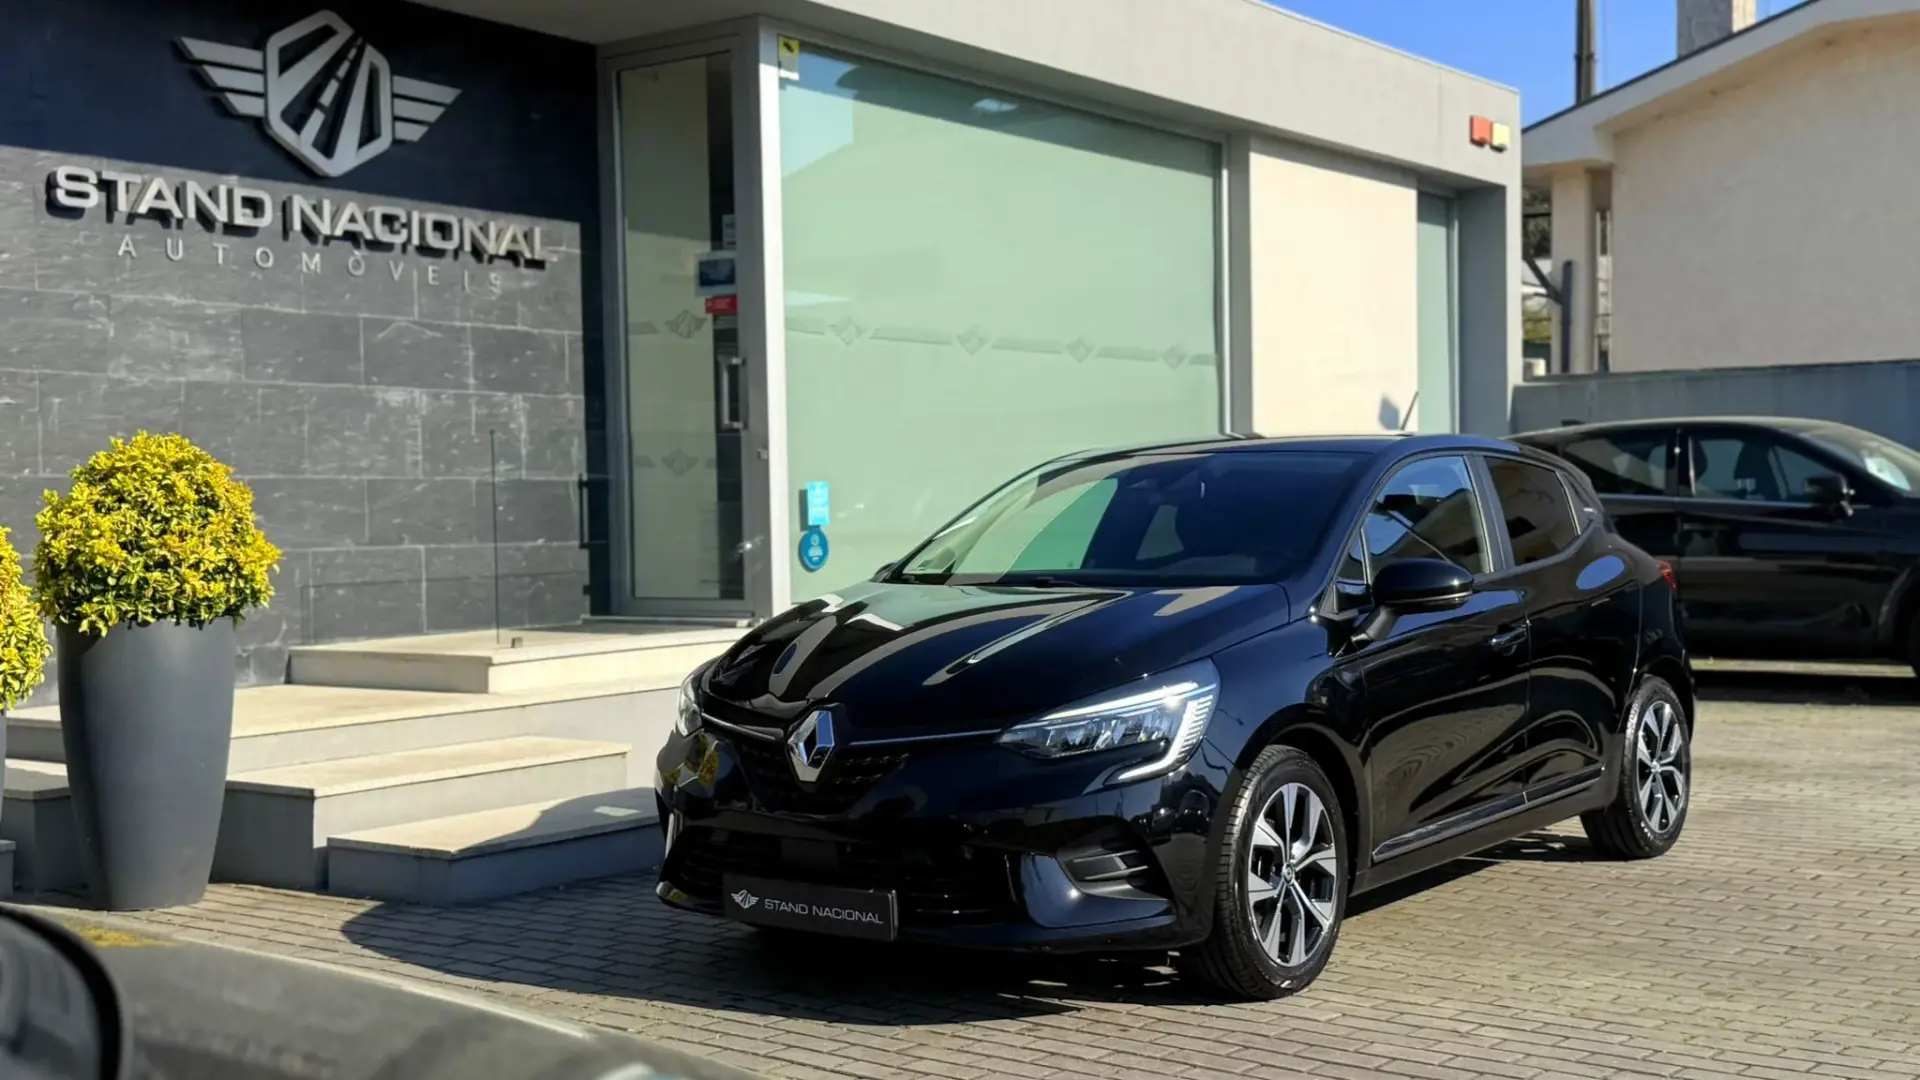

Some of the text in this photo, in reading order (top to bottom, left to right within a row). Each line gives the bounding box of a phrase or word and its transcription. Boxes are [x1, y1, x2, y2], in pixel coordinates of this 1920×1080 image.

[56, 165, 559, 262] STAND NACIONAL
[764, 898, 884, 924] STAND NACIONAL
